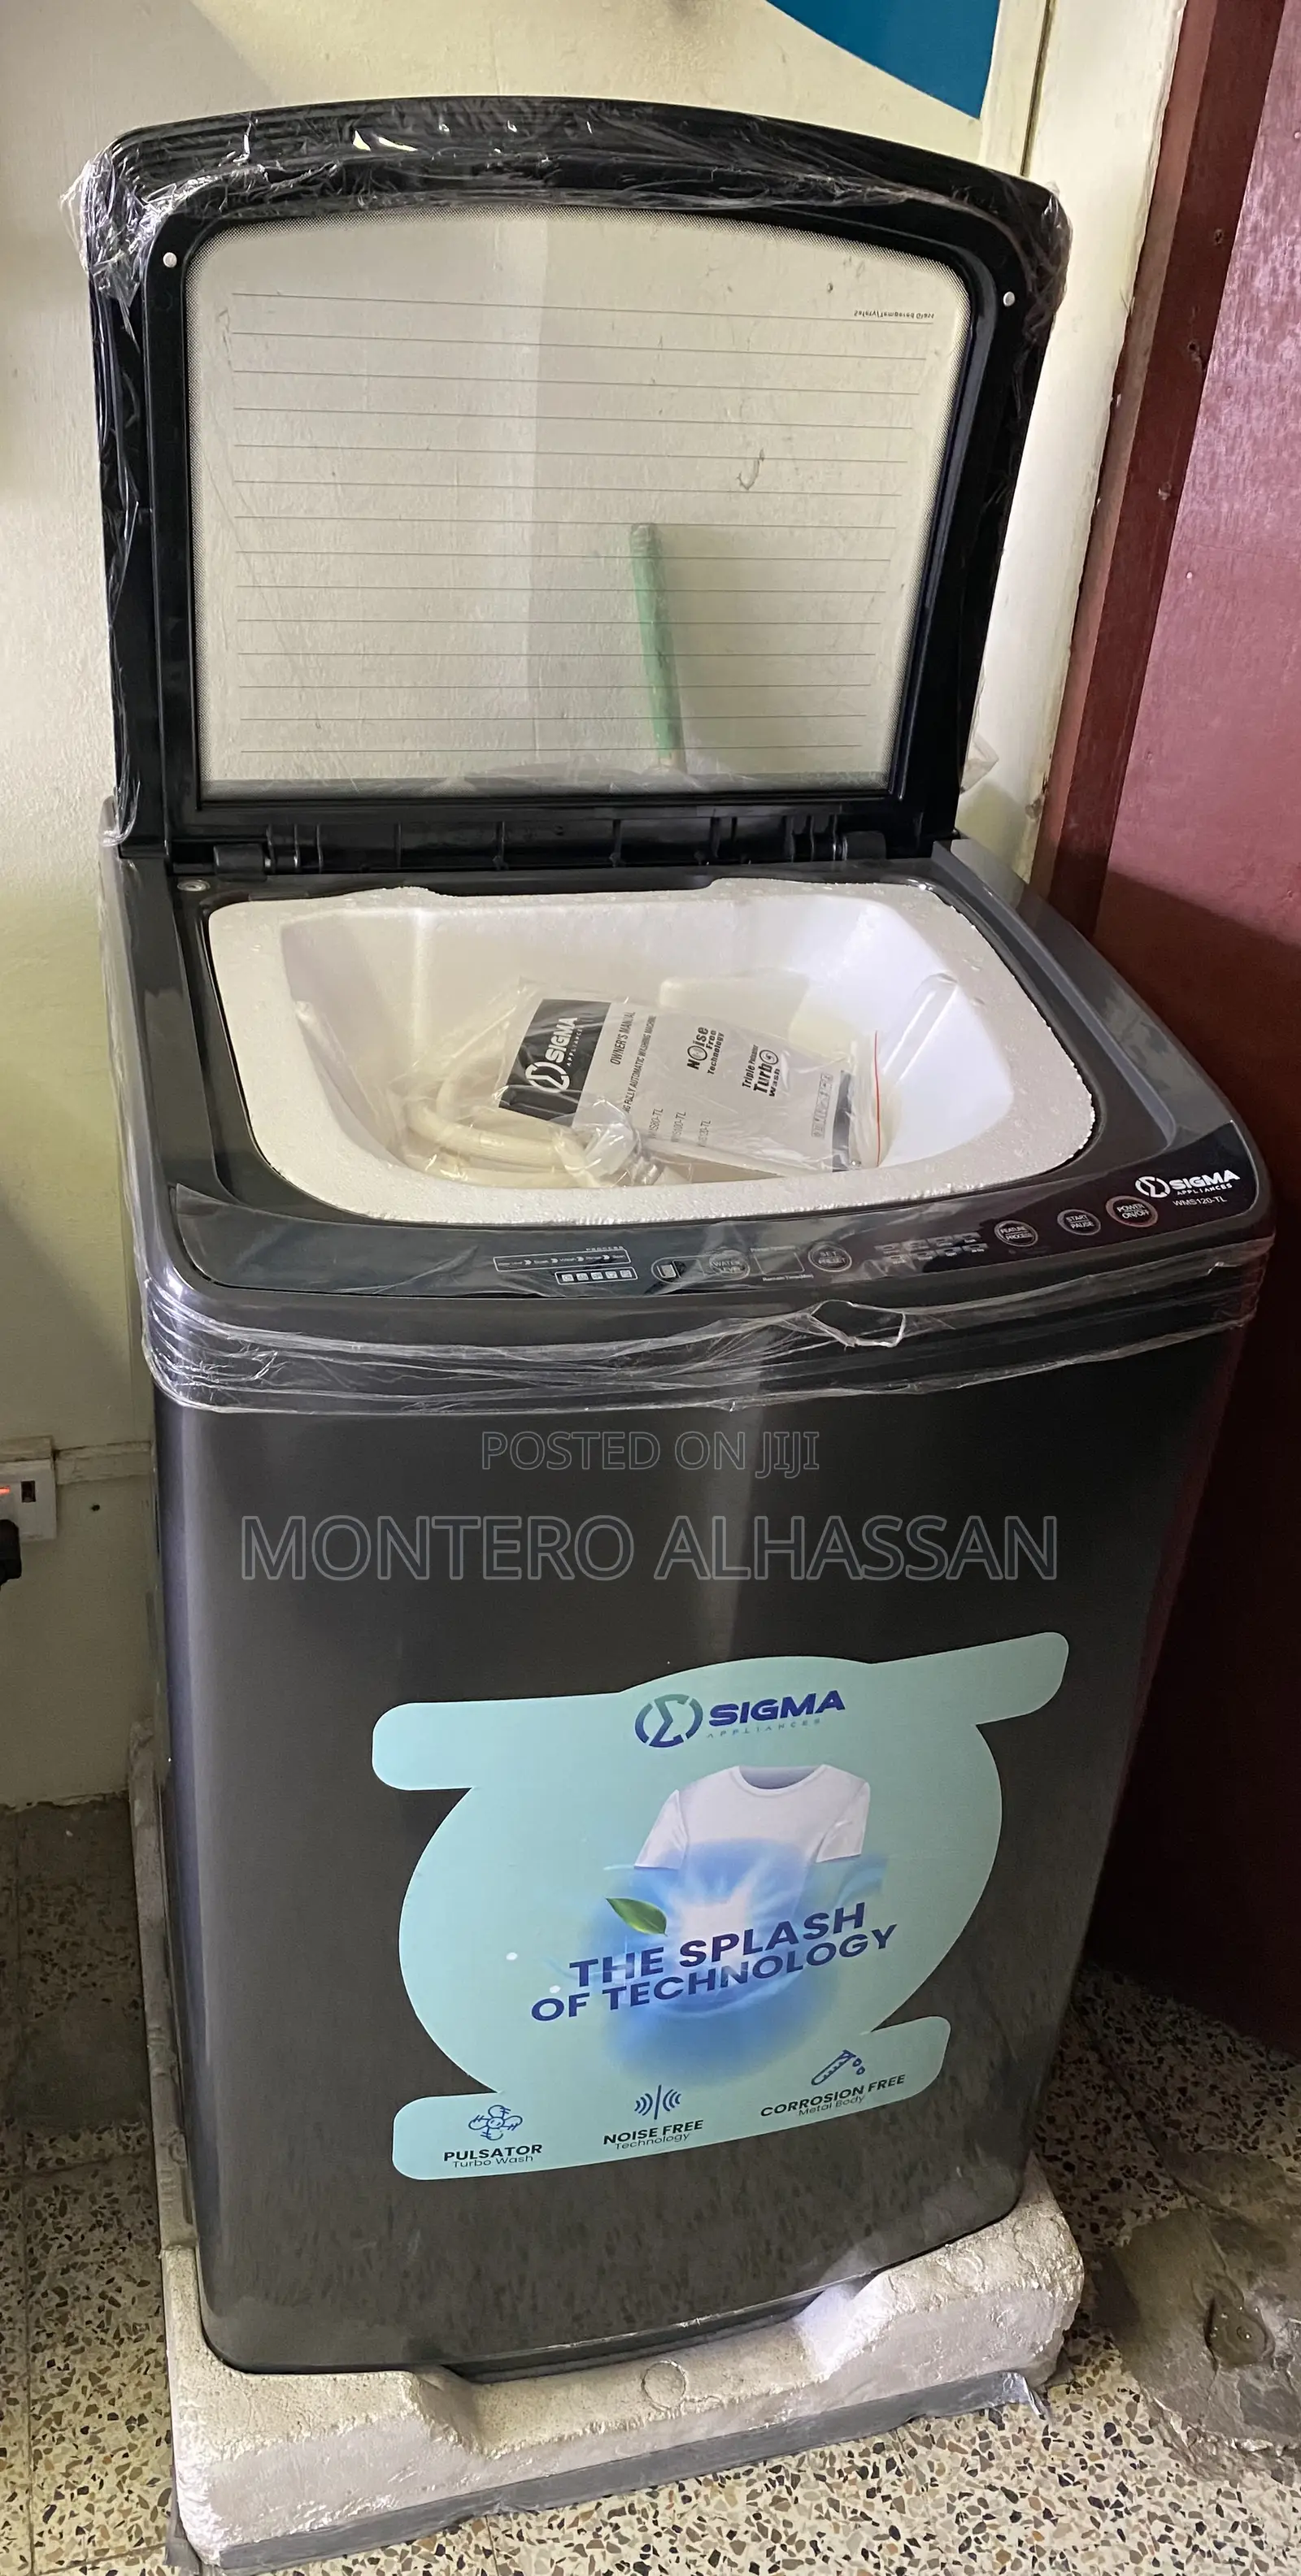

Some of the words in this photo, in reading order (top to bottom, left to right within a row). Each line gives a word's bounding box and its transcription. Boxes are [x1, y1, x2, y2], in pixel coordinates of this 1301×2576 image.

[545, 1017, 578, 1063] SIGMA
[611, 1033, 628, 1066] OWNER'S
[706, 1030, 717, 1049] Free
[707, 1032, 724, 1075] Technology
[624, 1088, 636, 1106] FULLY
[630, 1056, 645, 1088] AUTOMATIC
[639, 1033, 651, 1058] WASHING
[742, 1063, 755, 1088] Triple
[1169, 1170, 1241, 1190] SIGMA
[1177, 1183, 1233, 1195] APPLIANCES
[1116, 1203, 1146, 1213] POWER
[1173, 1196, 1228, 1206] WMS120-TL
[1122, 1210, 1150, 1218] ON/OFF
[709, 1690, 846, 1727] SIGMA
[706, 1718, 820, 1739] APPLIANCES
[569, 1946, 664, 1987] THE
[680, 1902, 866, 1967] SPLASH
[531, 1991, 590, 2022] OF
[602, 1923, 898, 2010] TECHNOLOGY
[760, 2085, 864, 2117] CORROSION
[868, 2074, 906, 2092] FREE
[798, 2102, 832, 2117] Metal
[835, 2094, 866, 2109] Body
[603, 2127, 659, 2145] NOISE
[663, 2119, 703, 2135] FREE
[615, 2131, 690, 2150] Technology
[444, 2144, 542, 2161] PULSATOR
[453, 2158, 491, 2168] Turbo
[496, 2154, 533, 2165] Wash
